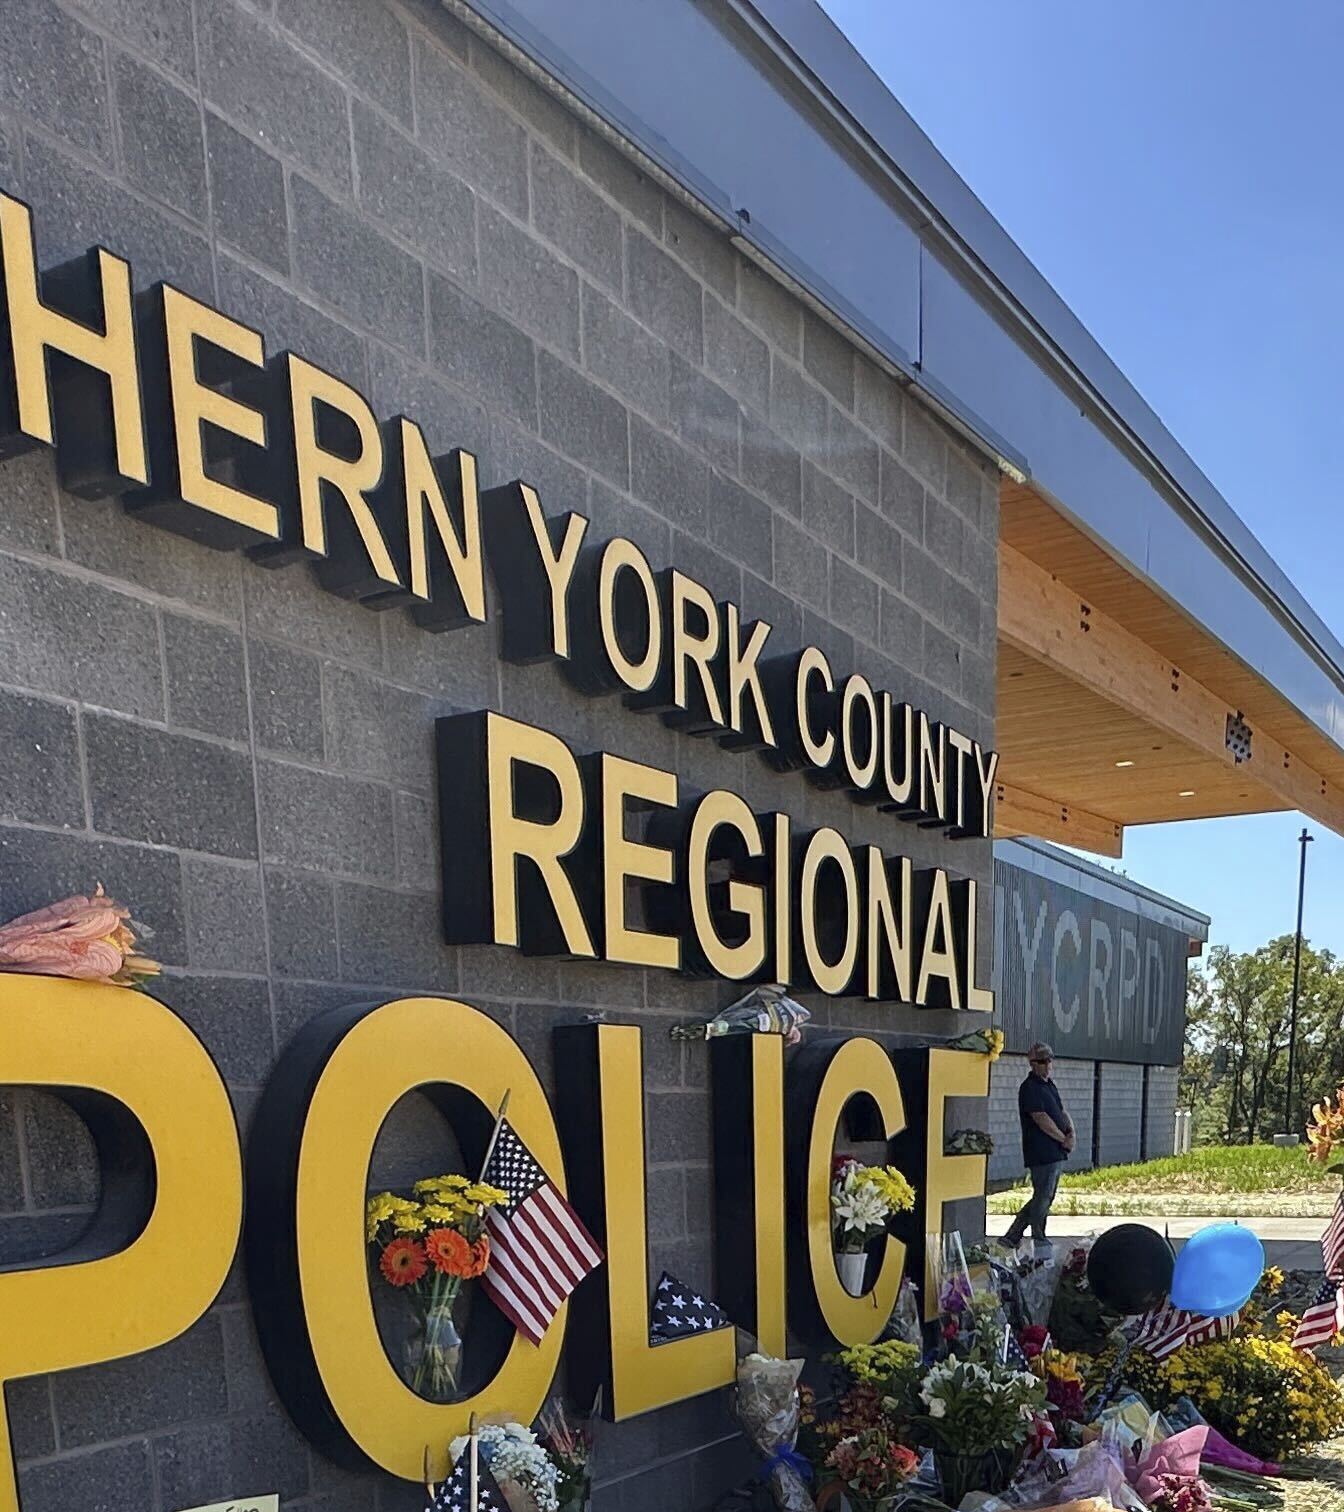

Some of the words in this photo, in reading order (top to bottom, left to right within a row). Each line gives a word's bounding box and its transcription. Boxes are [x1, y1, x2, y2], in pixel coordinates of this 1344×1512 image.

[520, 481, 775, 748] YORK
[797, 646, 999, 838] COUNTY
[487, 711, 993, 1012] REGIONAL
